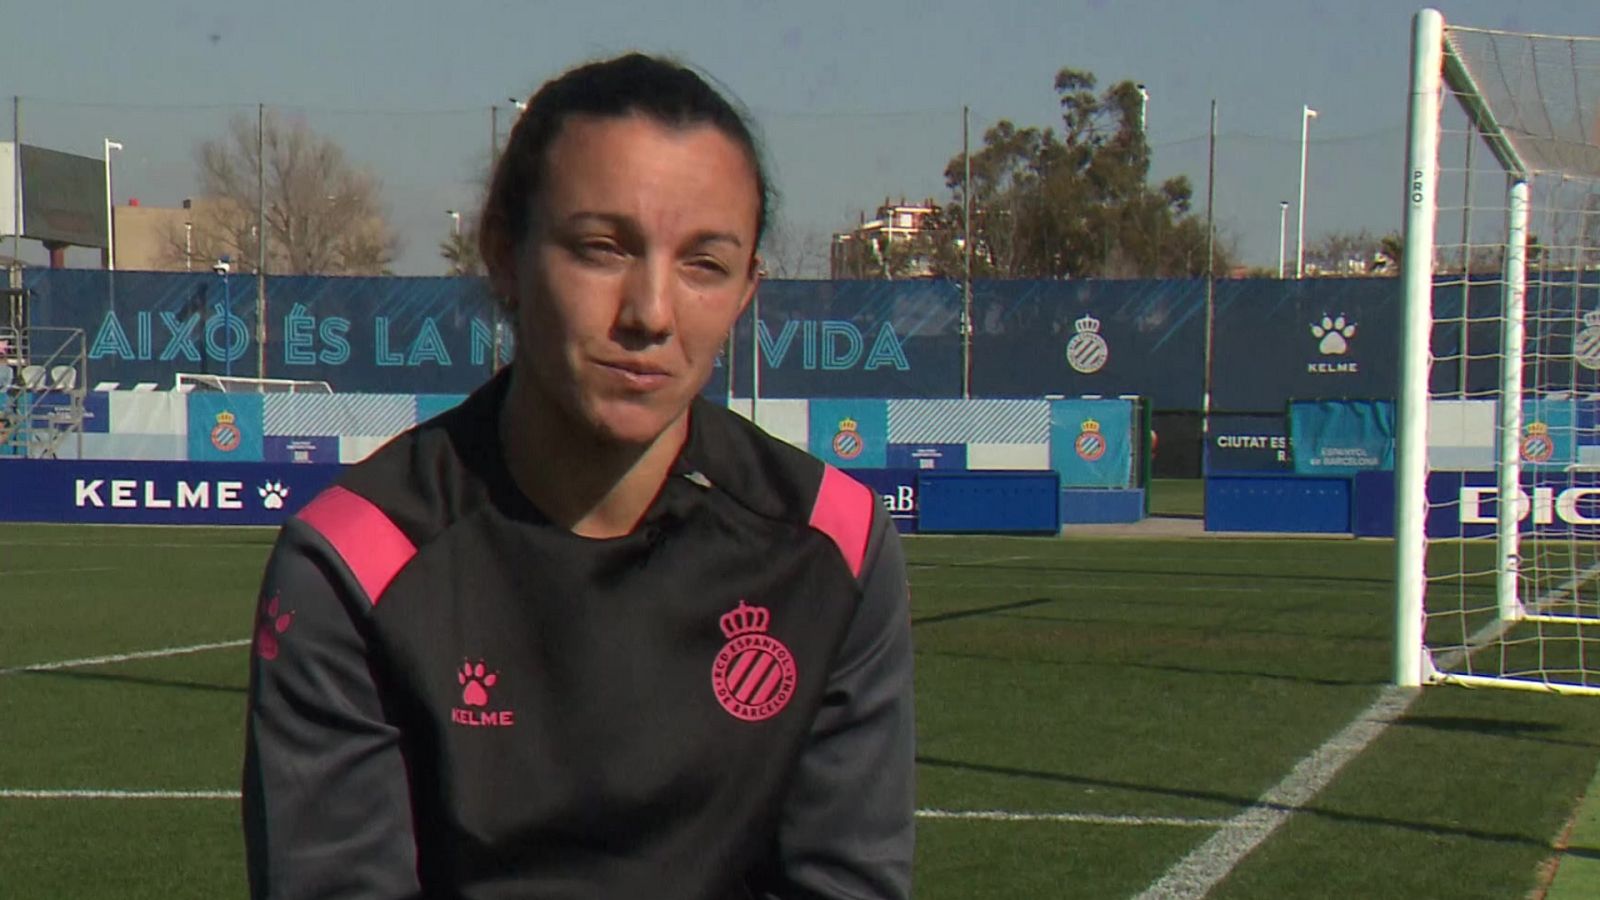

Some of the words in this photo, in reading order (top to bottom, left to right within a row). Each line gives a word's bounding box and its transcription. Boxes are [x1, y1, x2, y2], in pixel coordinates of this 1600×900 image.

[1412, 170, 1424, 203] PRO
[284, 302, 352, 366] ÉS
[375, 316, 453, 366] LA
[757, 320, 911, 371] VIDA
[1306, 363, 1359, 373] KELME
[1217, 435, 1268, 449] CIUTAT
[75, 479, 244, 509] KELME
[729, 636, 791, 669] ESPANYOL
[451, 707, 515, 726] KELME
